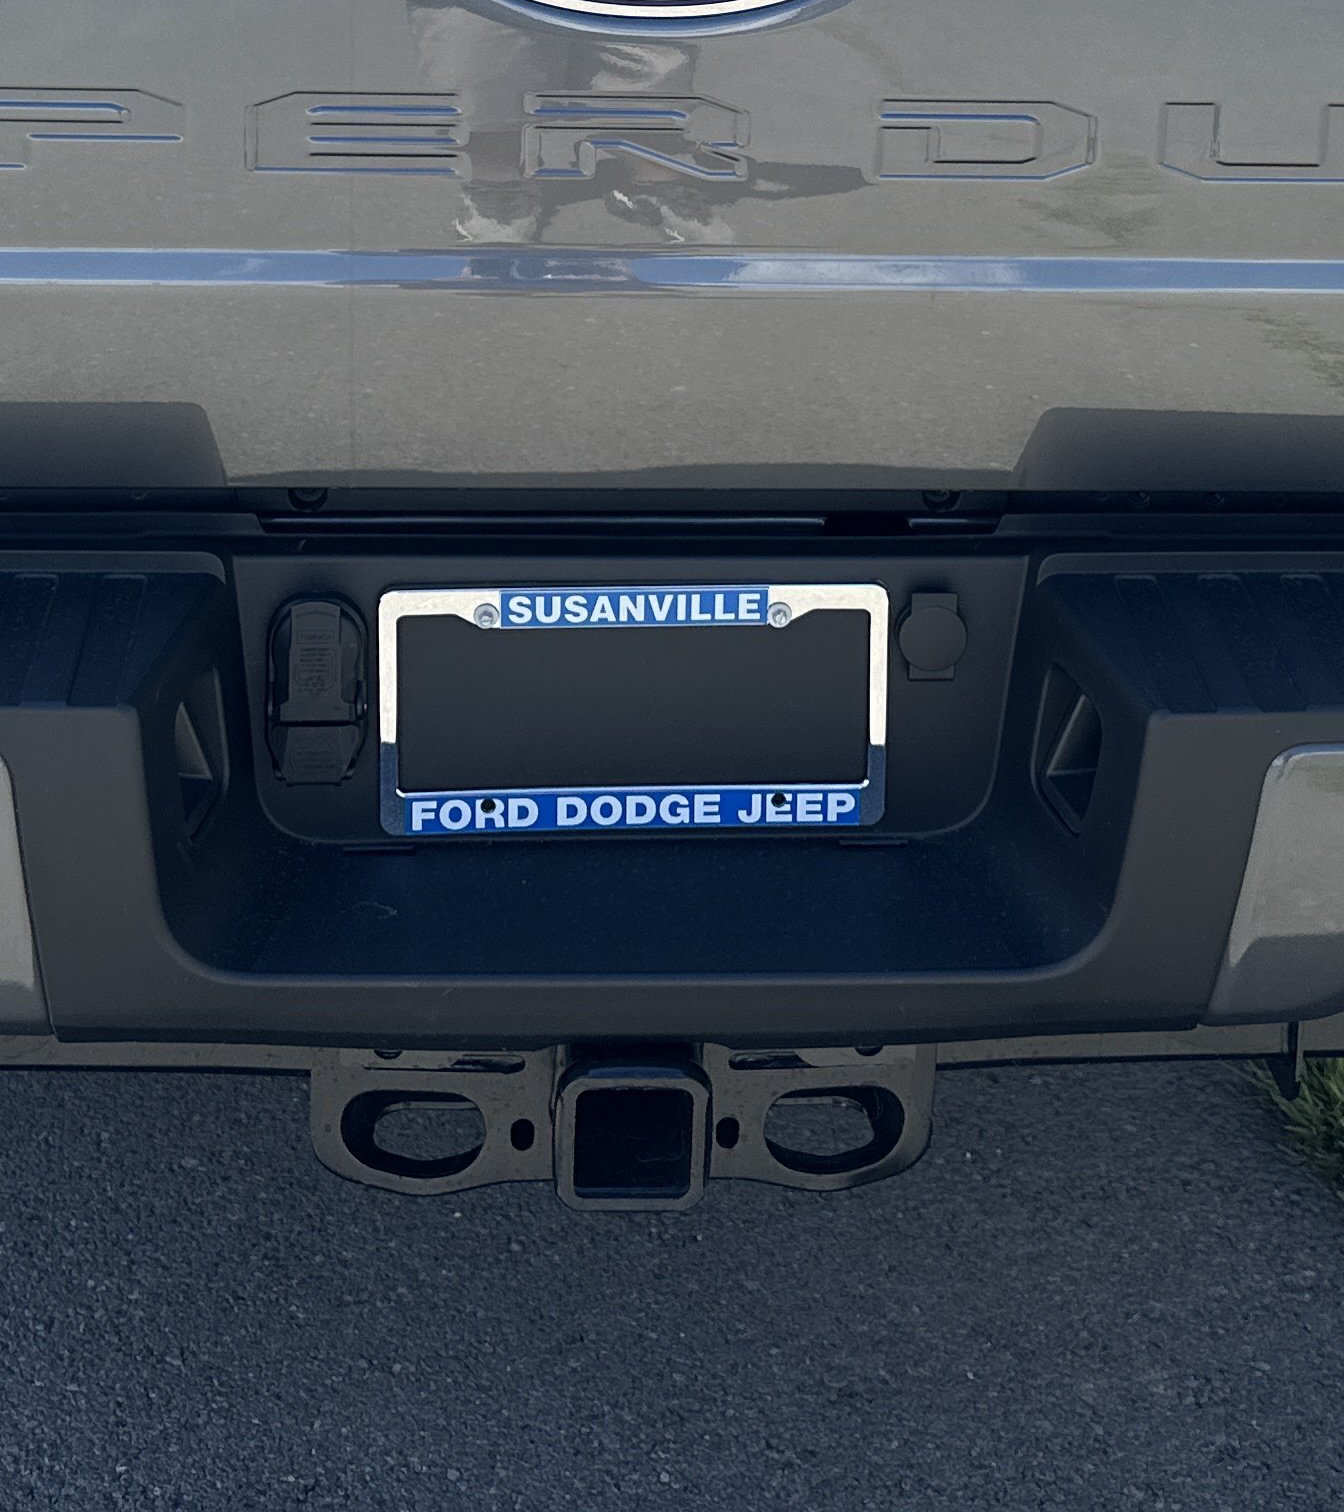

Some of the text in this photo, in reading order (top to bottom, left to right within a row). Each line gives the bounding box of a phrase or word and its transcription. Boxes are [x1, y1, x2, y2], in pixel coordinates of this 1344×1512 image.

[507, 592, 762, 625] SUSANVILLE
[411, 793, 856, 831] FORD DODGE JEEP
